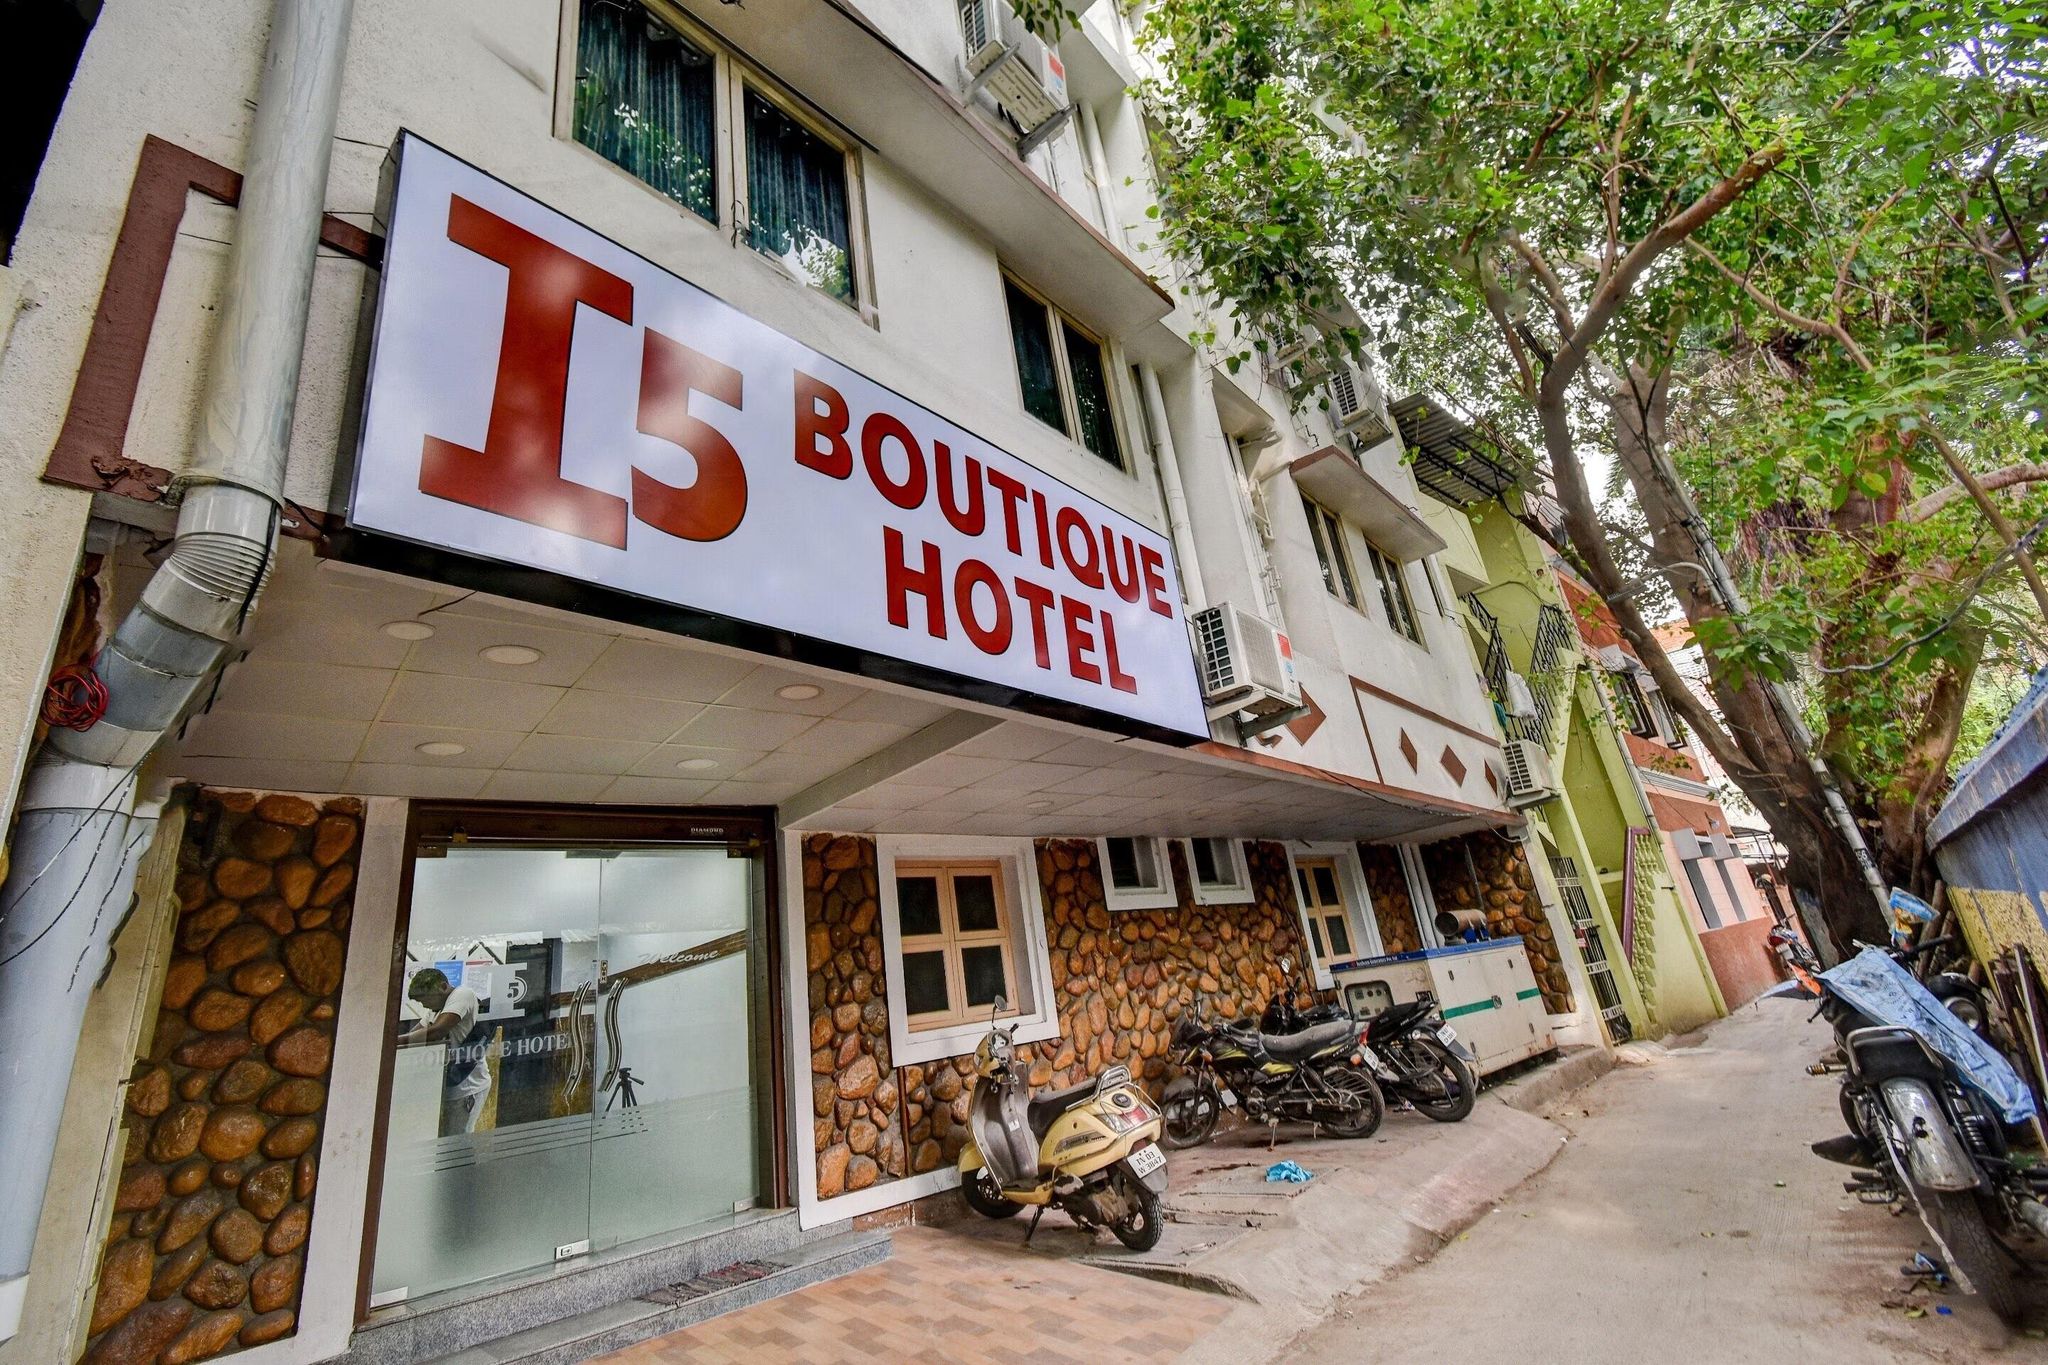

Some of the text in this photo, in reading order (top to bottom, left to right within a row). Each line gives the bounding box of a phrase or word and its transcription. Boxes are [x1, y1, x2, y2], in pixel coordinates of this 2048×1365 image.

[418, 194, 1173, 618] I5 BOUTIQUE
[884, 527, 1138, 693] HOTEL
[639, 949, 720, 965] Welcome
[517, 1032, 574, 1057] HOTE
